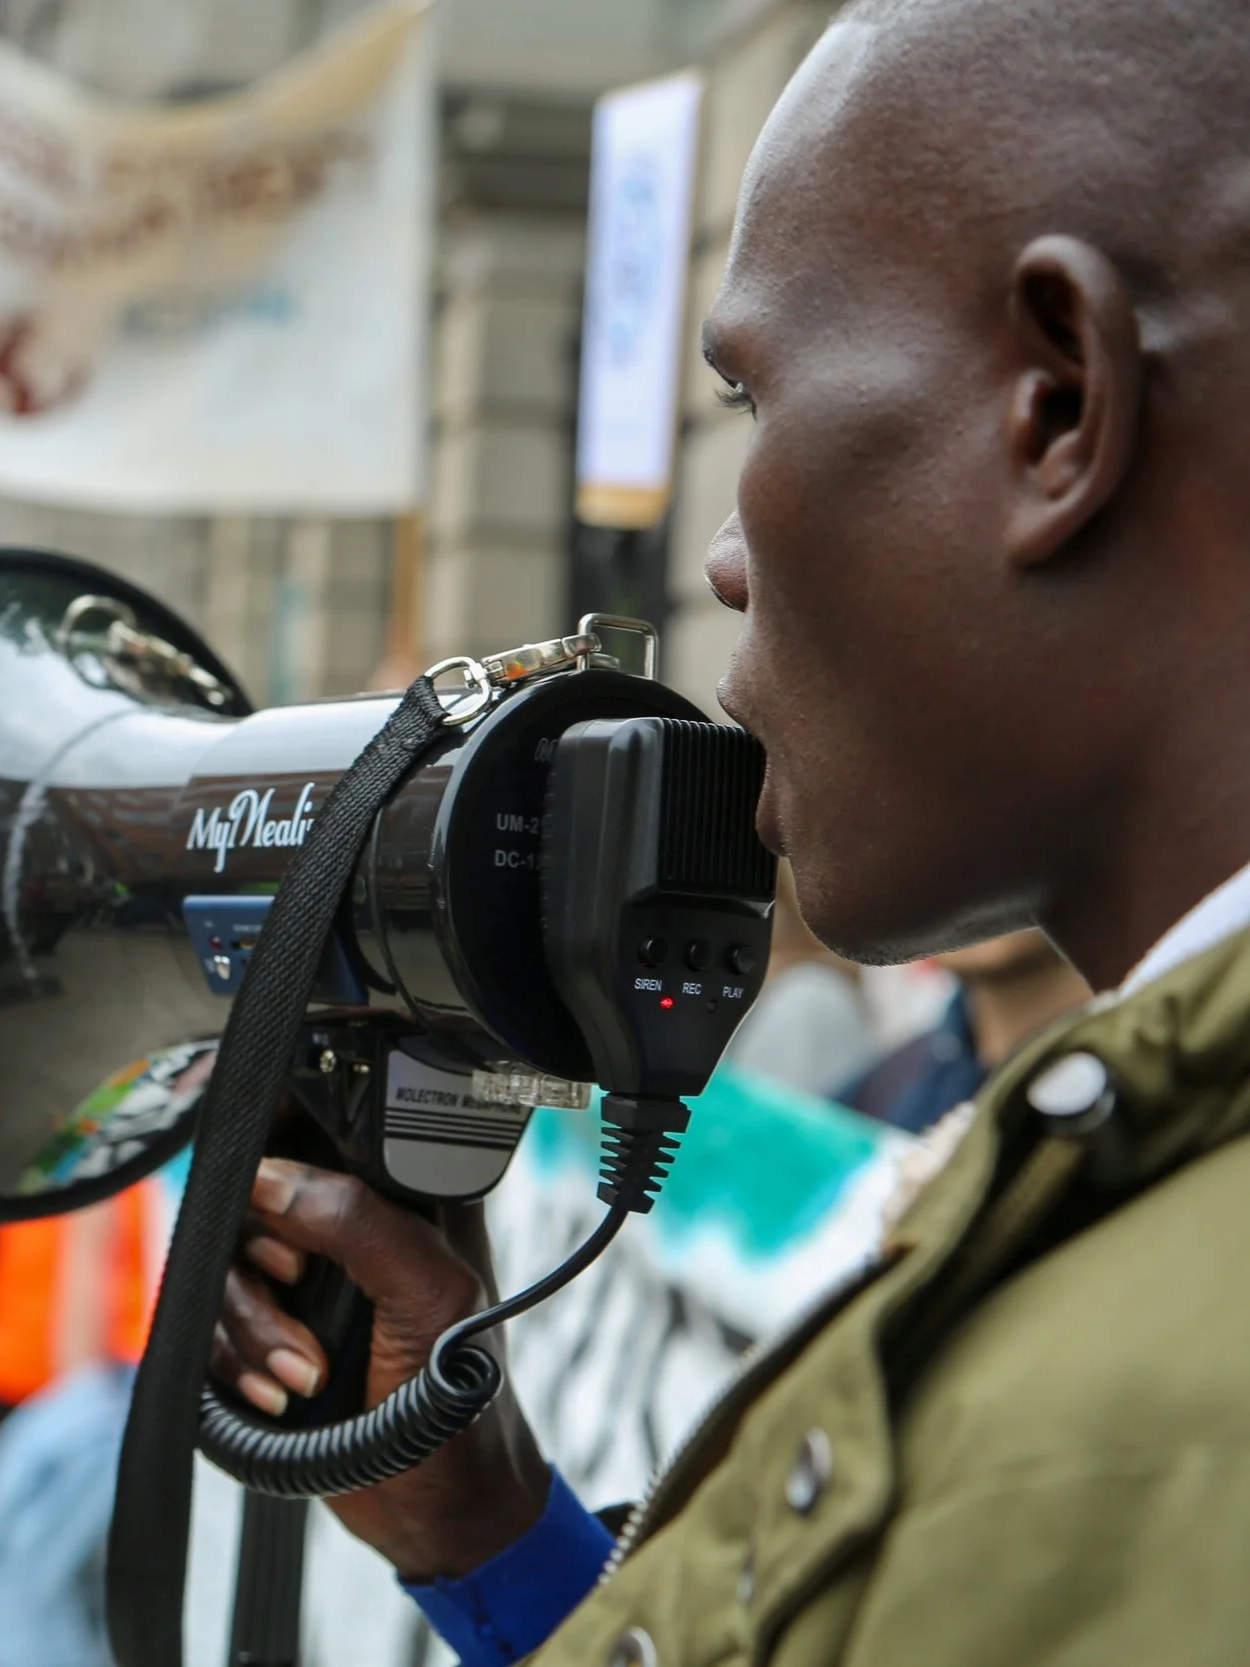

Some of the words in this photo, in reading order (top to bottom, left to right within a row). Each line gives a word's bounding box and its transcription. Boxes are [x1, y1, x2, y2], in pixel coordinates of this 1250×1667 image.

[494, 849, 539, 871] DC-1
[634, 977, 662, 992] SIREN
[682, 981, 702, 995] REC
[722, 986, 745, 999] PLAY
[395, 1086, 460, 1107] MOLECTRON
